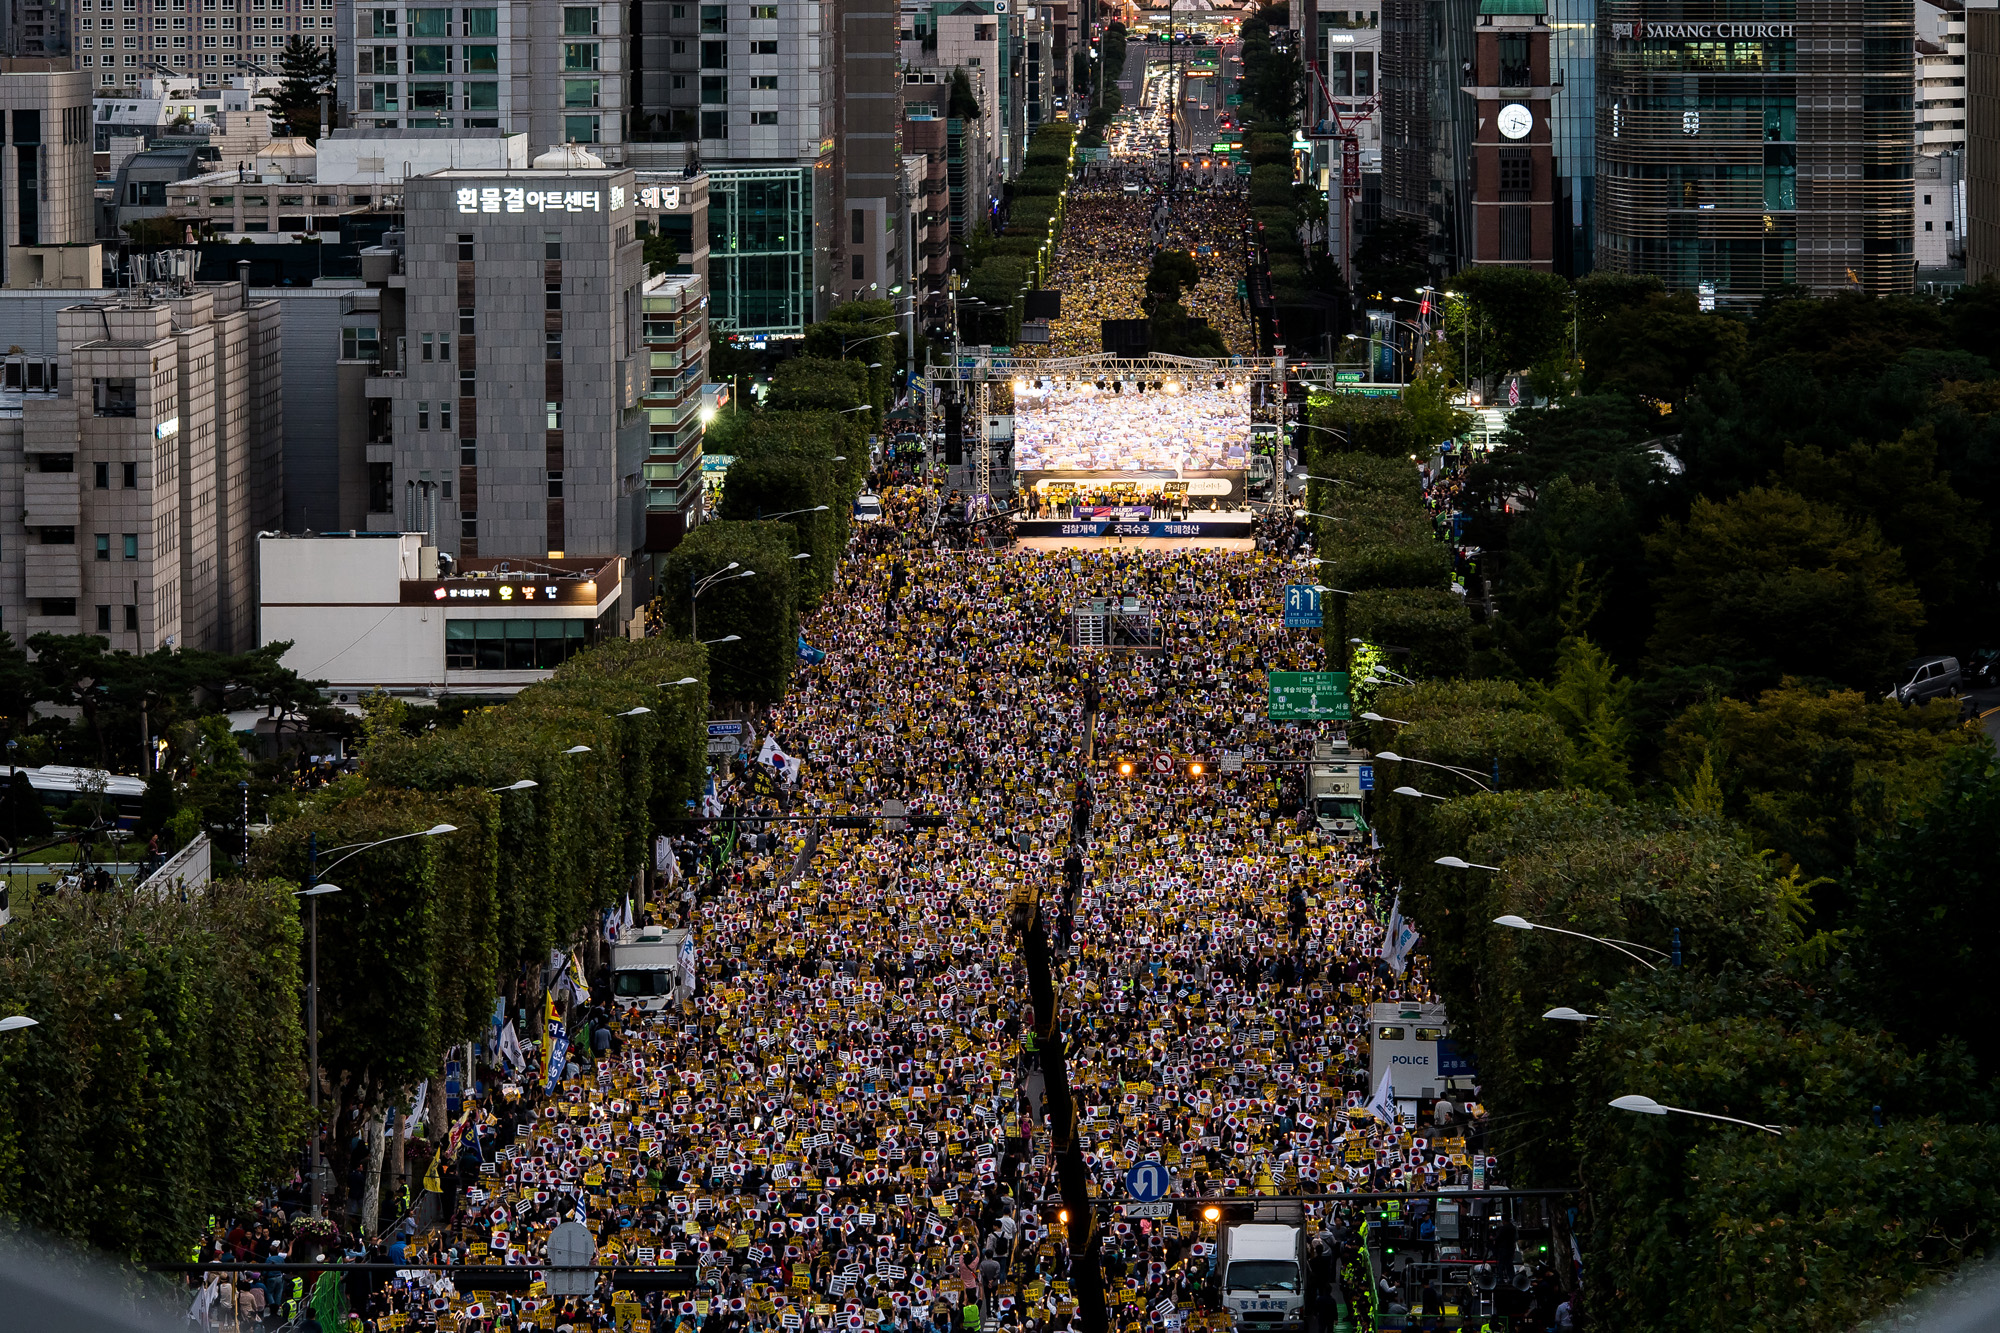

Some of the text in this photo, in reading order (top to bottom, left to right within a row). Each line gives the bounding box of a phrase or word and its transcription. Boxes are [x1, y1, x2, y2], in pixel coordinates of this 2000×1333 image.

[1717, 22, 1793, 38] CHURCH
[706, 456, 720, 464] CAR
[1061, 524, 1200, 534] 검찰개혁 조국수호 적폐청산
[1392, 1055, 1429, 1065] POLICE
[1142, 1205, 1168, 1216] 신호시
